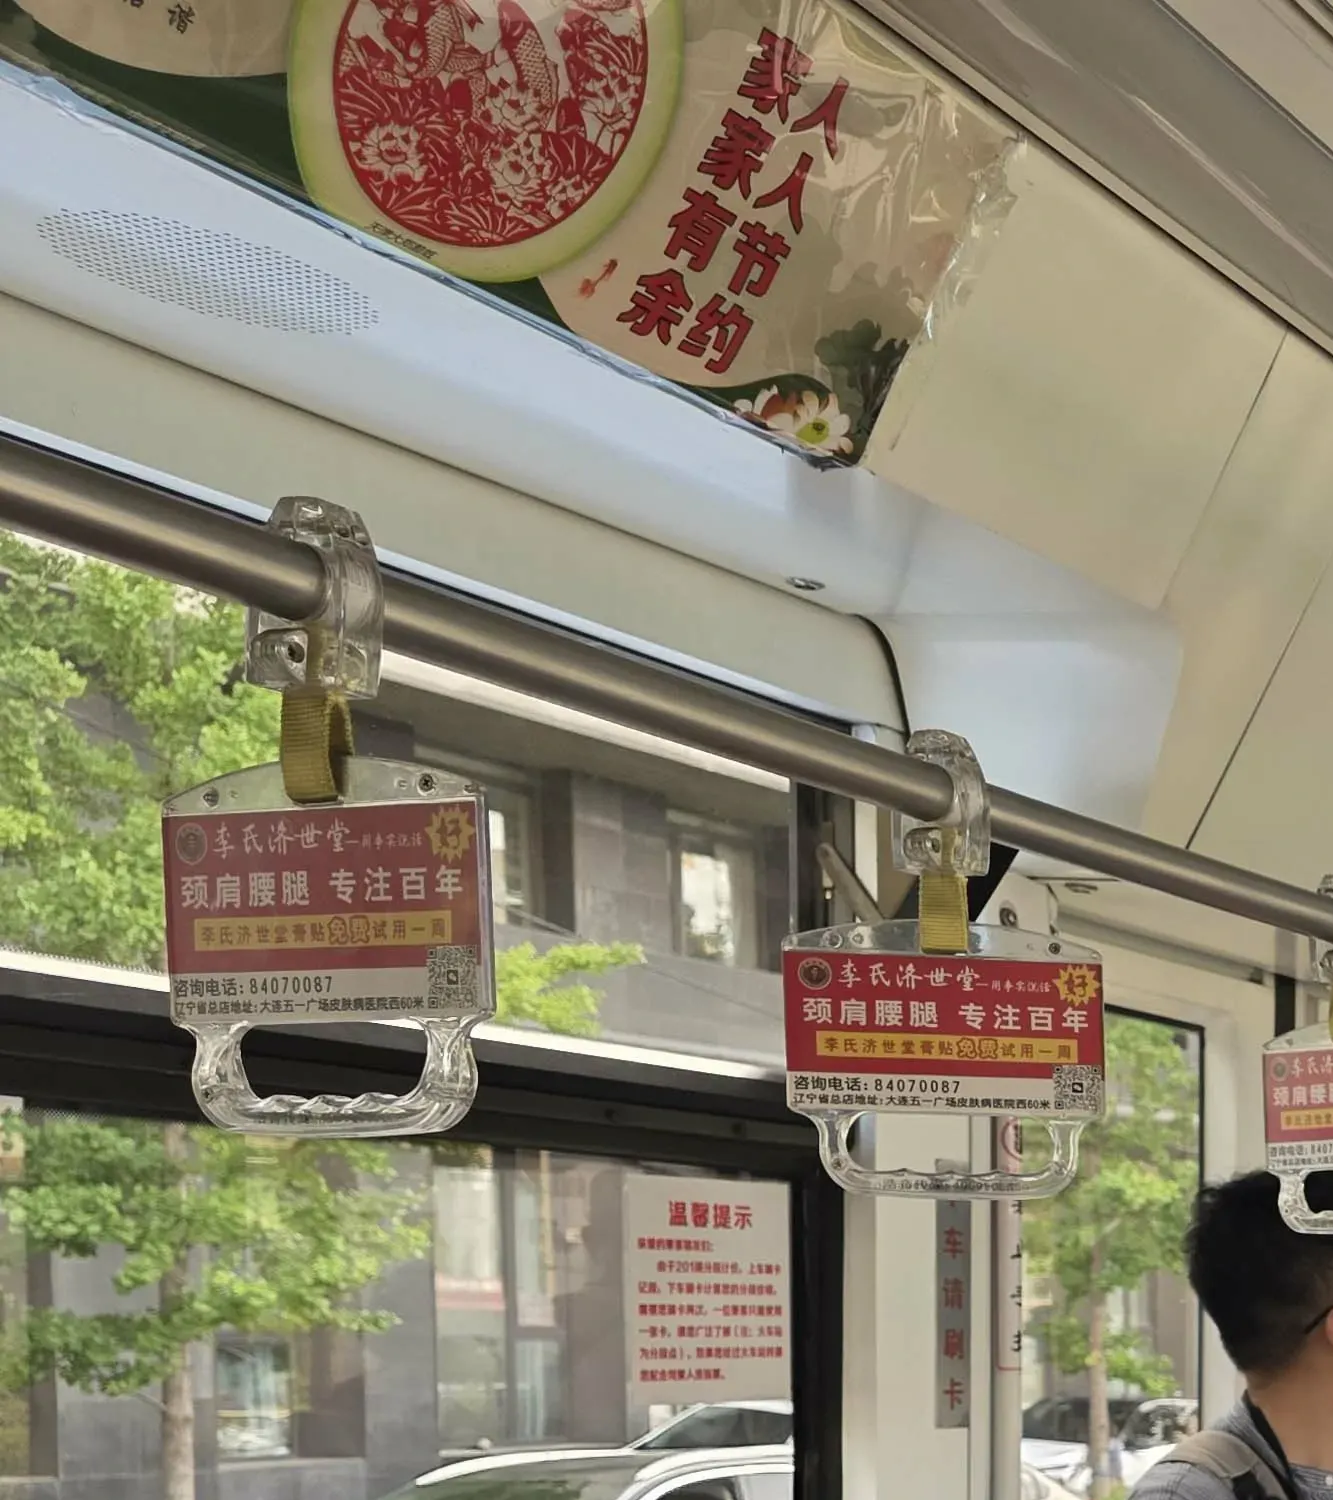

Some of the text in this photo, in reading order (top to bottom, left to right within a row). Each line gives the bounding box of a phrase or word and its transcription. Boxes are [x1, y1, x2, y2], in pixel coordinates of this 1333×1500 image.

[616, 27, 814, 346] 家家有余
[678, 76, 848, 374] 人人节约
[212, 817, 350, 860] 李氏济世堂
[180, 865, 463, 910] 颈肩腰腿 专注百年
[837, 958, 980, 992] 李氏济世堂
[802, 997, 1089, 1033] 颈肩腰腿 专注百年
[824, 1037, 1072, 1060] 李氏济世堂膏贴免费试用一周
[669, 1200, 752, 1229] 温馨提示
[942, 1200, 965, 1410] 车请刷卡
